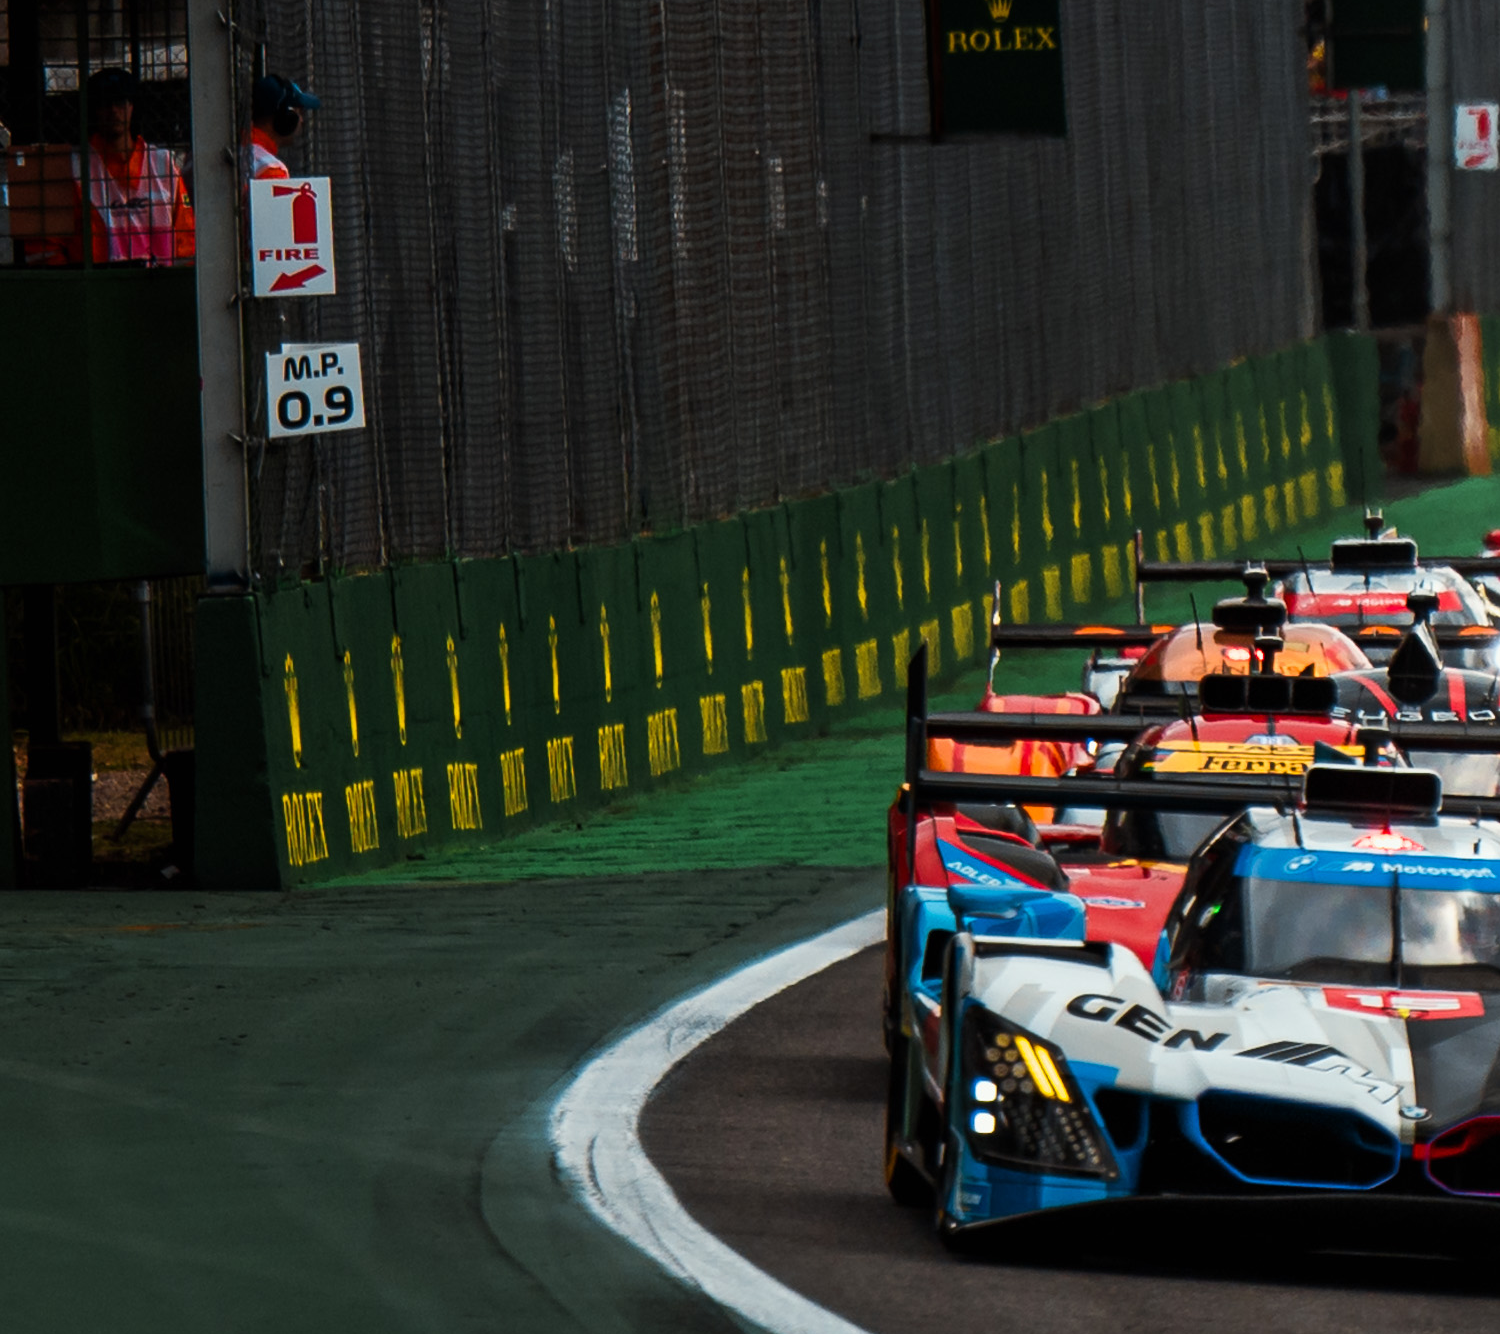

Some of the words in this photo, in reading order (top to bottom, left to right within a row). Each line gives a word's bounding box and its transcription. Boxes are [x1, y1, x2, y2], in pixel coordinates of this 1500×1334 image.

[947, 26, 1057, 54] ROLEX
[258, 247, 320, 262] FIRE
[283, 352, 344, 382] M.P.
[277, 385, 355, 430] 0.9
[1382, 862, 1496, 880] Motorsport
[1344, 990, 1462, 1012] 15
[1065, 993, 1232, 1052] GEN
